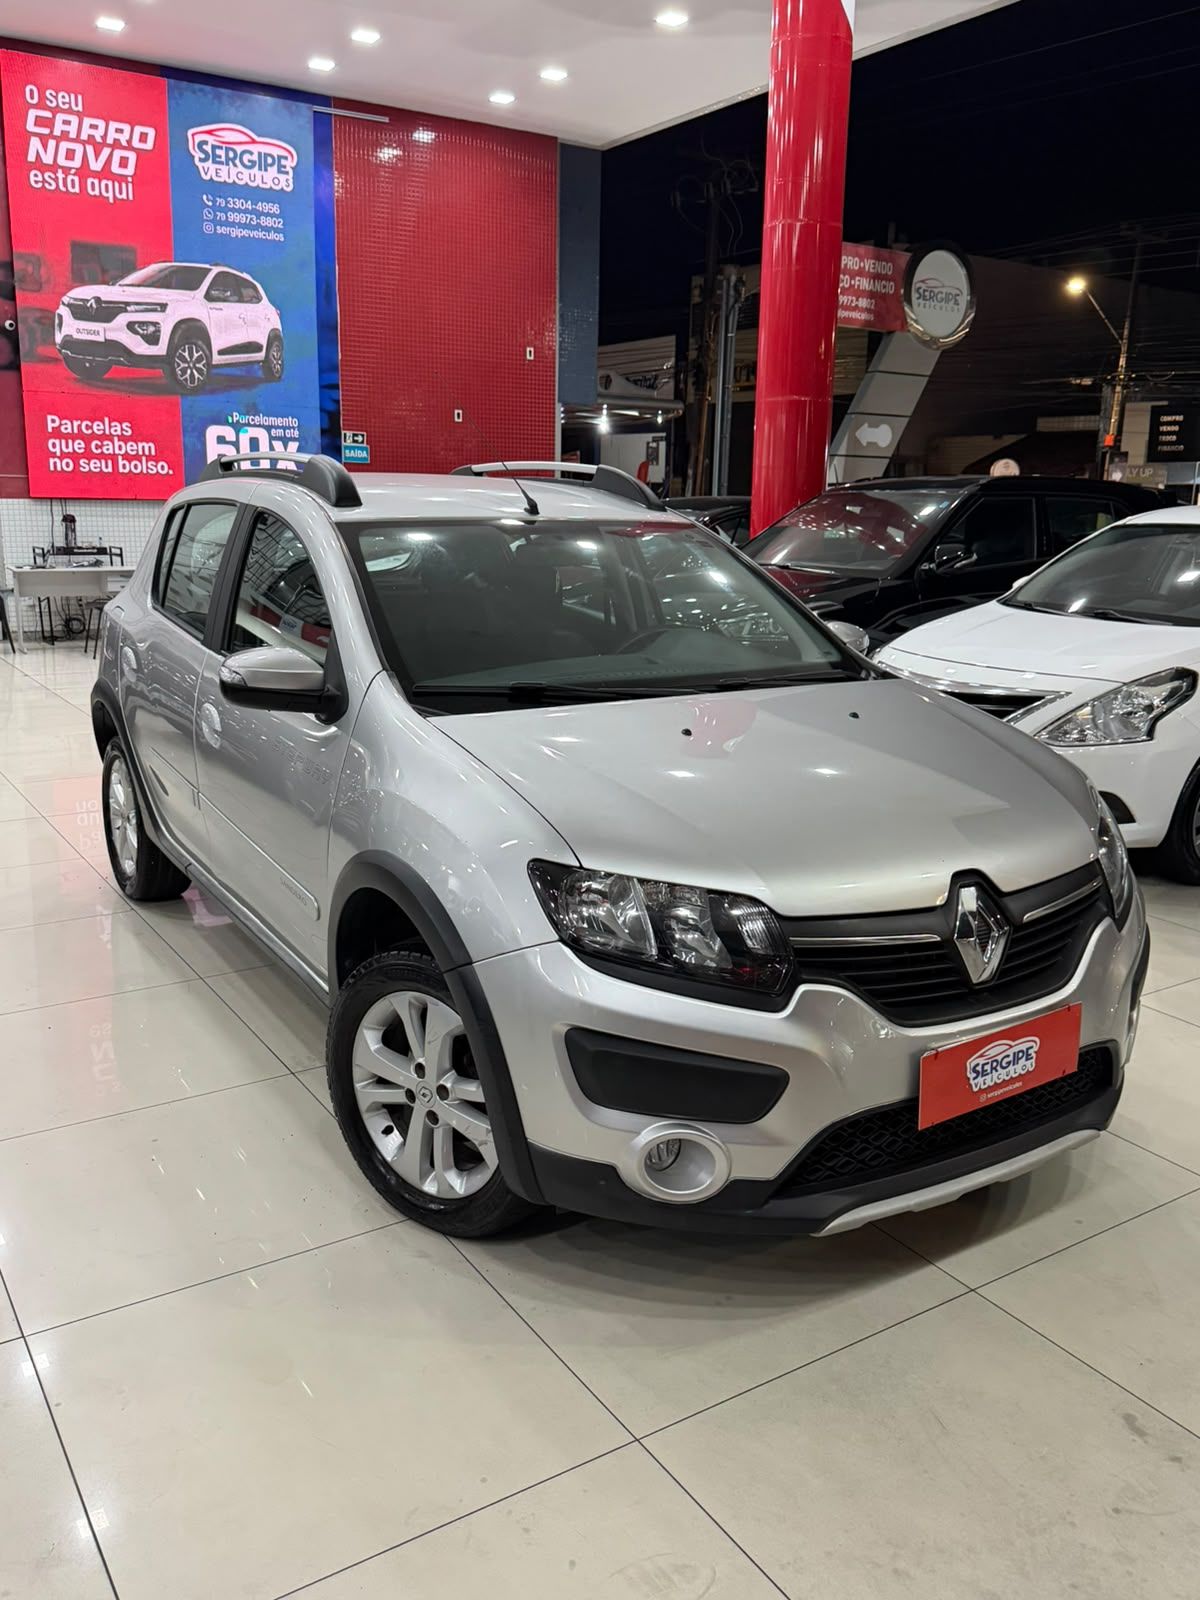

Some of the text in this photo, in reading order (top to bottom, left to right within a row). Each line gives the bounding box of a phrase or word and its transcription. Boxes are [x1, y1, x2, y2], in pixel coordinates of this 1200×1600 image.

[45, 89, 83, 112] seu
[26, 108, 156, 151] CARRO
[27, 136, 137, 176] NOVO
[196, 140, 290, 175] SERGIPE
[29, 168, 133, 204] está aqui
[227, 197, 281, 215] 3304-4956
[227, 211, 284, 229] 99973-8802
[216, 224, 285, 243] sergipeveiculos
[841, 255, 860, 270] PRO
[838, 295, 876, 309] 9973-8802
[916, 286, 961, 307] SERGIPE
[75, 327, 101, 337] OUTSIDER
[46, 415, 132, 437] Parcelas
[233, 412, 299, 428] Parcelamento
[271, 428, 300, 439] em até
[47, 436, 156, 458] que cabem
[345, 448, 369, 458] SAÍDA
[49, 457, 174, 476] no seu bolso.
[972, 1046, 1034, 1081] SERGIPE
